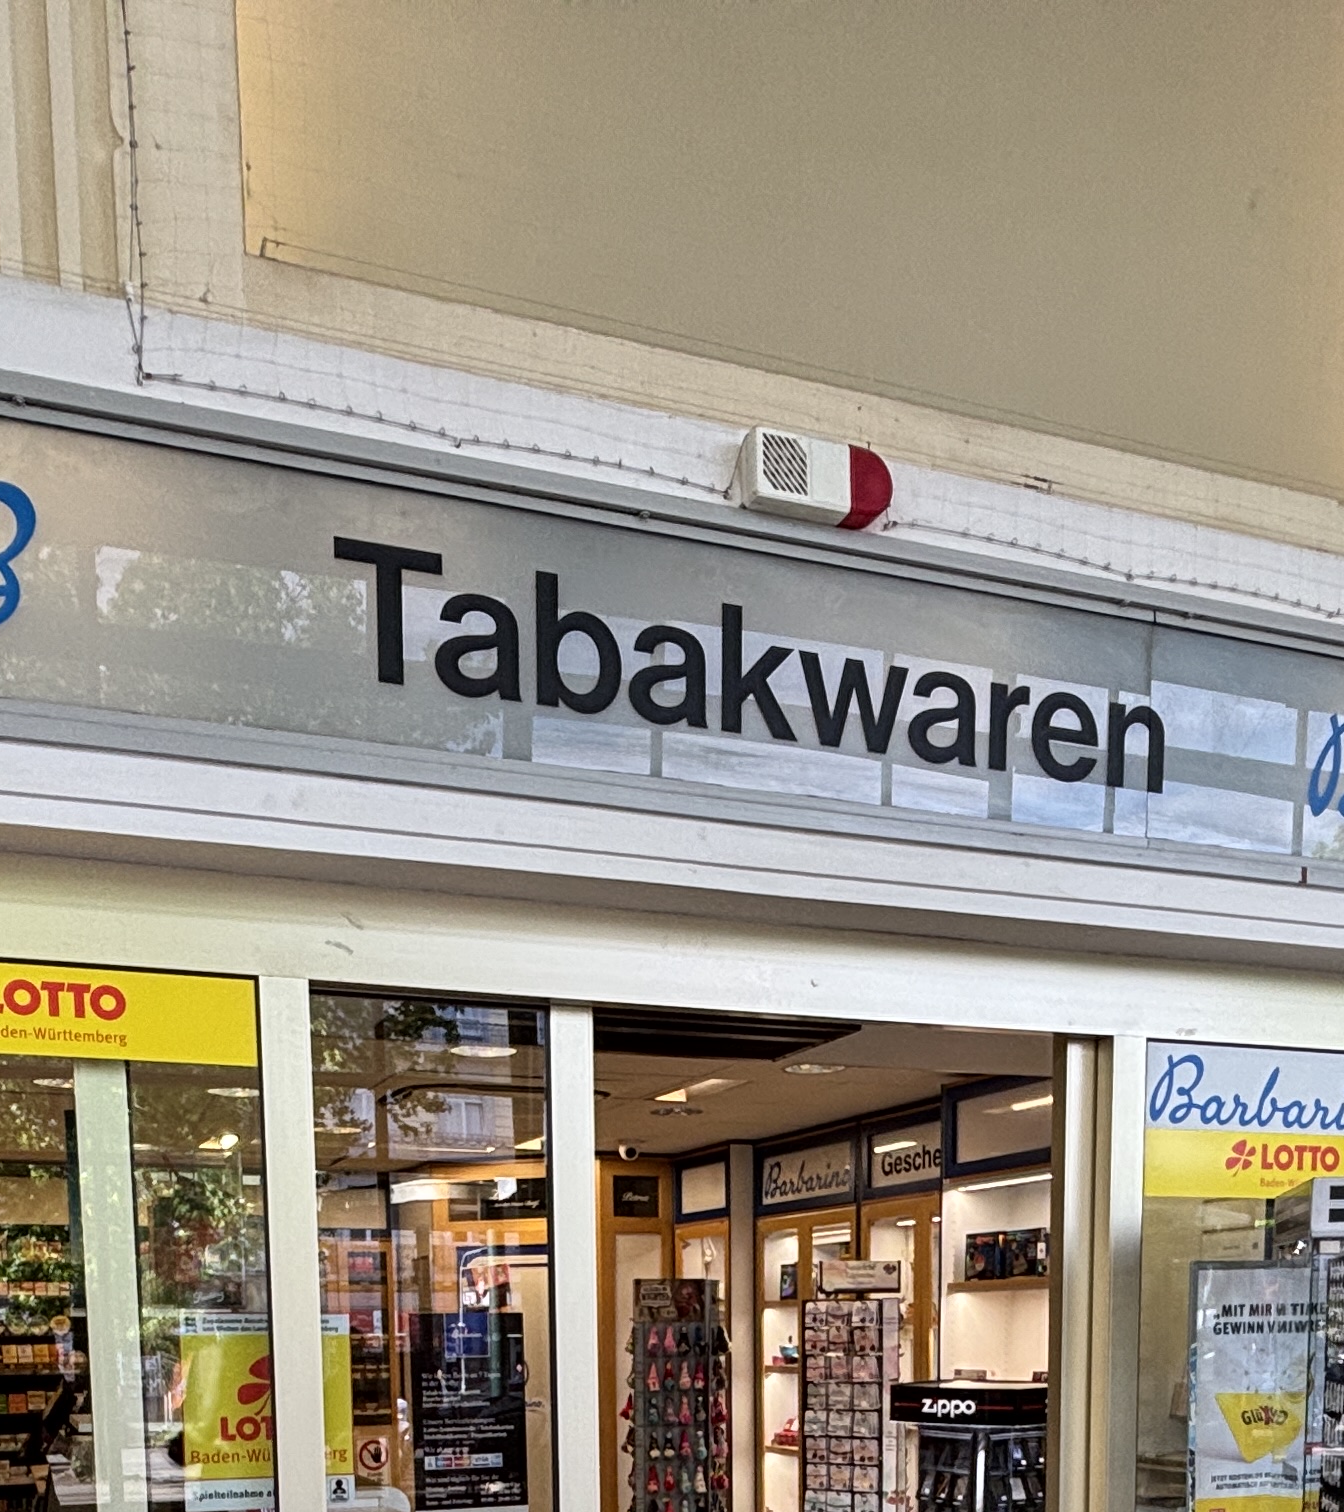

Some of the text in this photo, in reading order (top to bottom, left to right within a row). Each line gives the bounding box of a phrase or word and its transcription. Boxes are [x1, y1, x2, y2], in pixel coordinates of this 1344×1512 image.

[333, 535, 1166, 794] Tabakwaren
[1261, 1144, 1340, 1172] LOTTO
[764, 1161, 851, 1199] Barbarino
[1249, 1303, 1273, 1318] MIR
[1213, 1321, 1265, 1336] GEWINN
